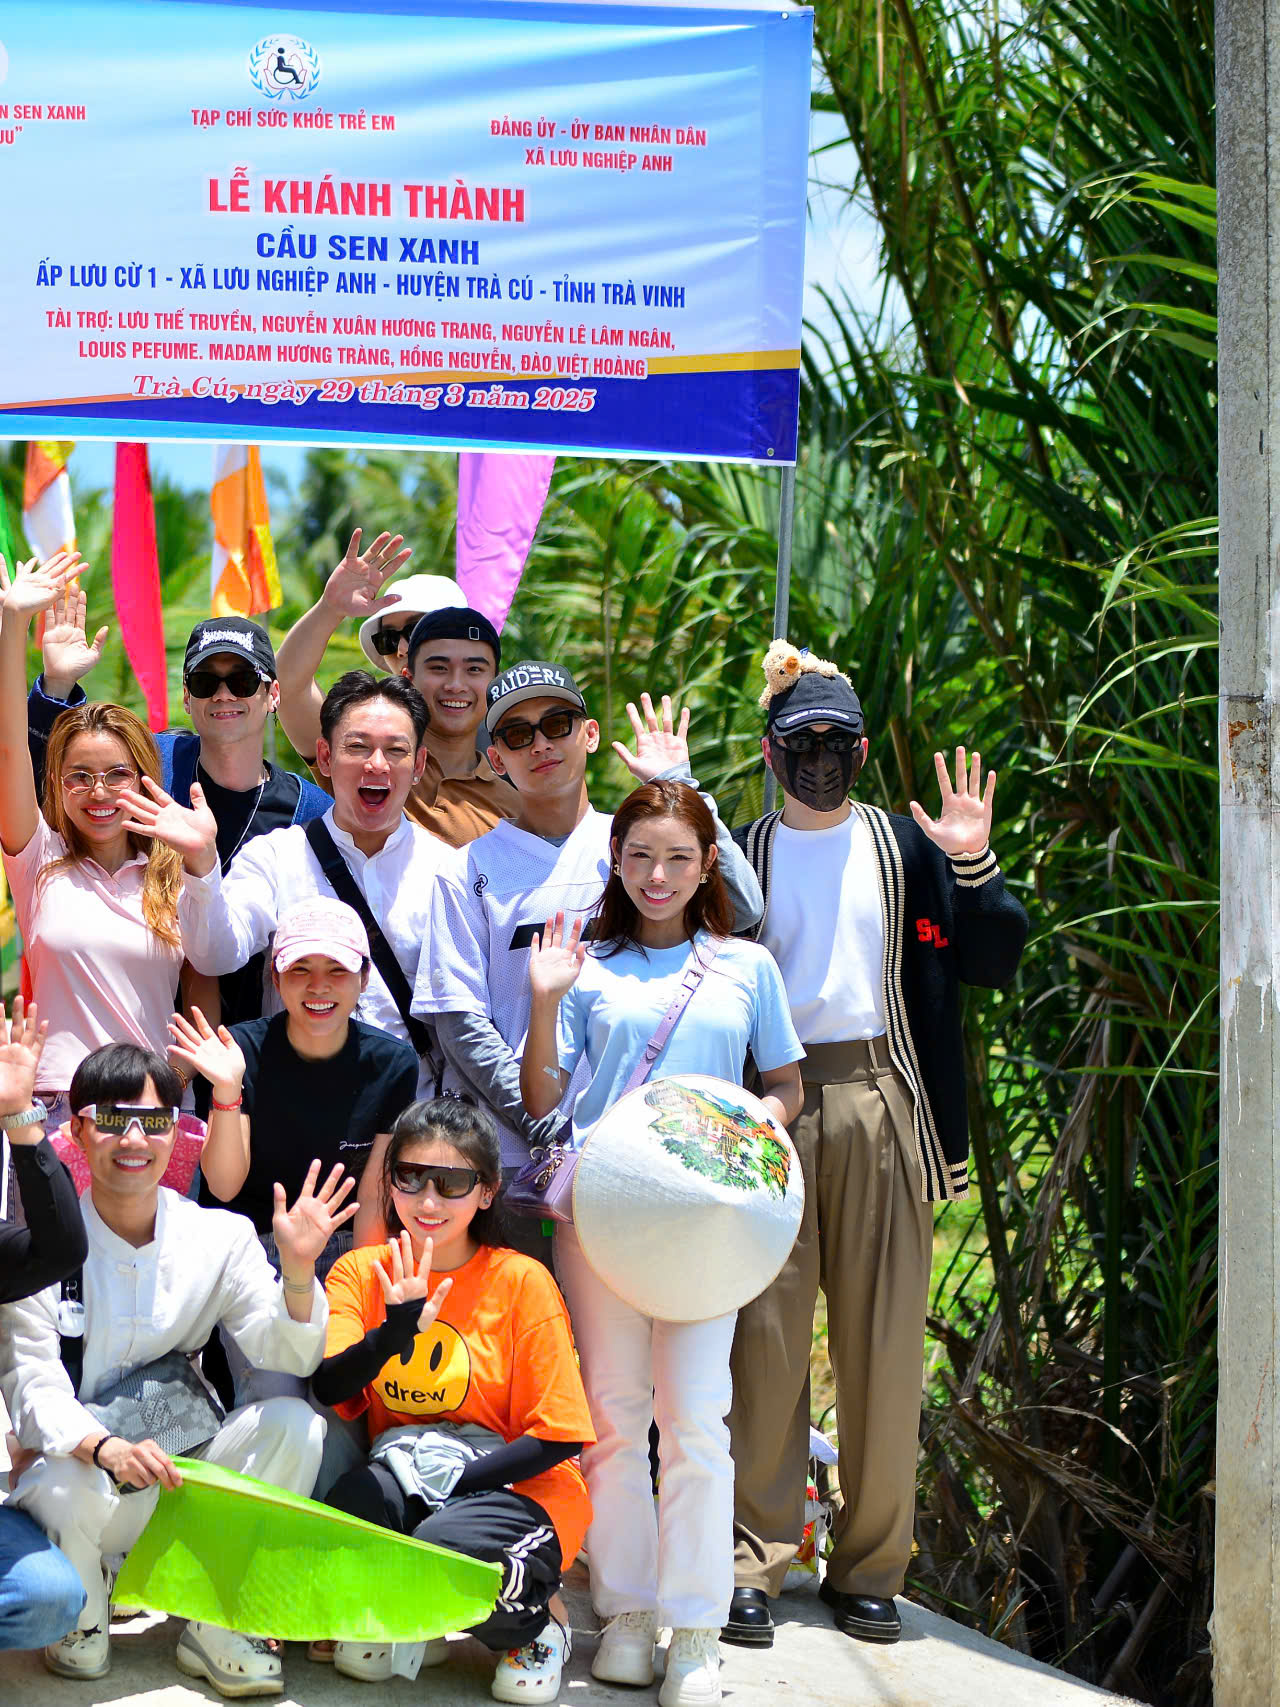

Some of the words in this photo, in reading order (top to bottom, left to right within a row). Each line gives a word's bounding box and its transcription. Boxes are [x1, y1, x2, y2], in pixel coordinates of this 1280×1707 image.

[13, 105, 42, 119] SEN
[47, 105, 86, 120] XANH
[192, 109, 220, 130] TẠP
[226, 108, 251, 127] CHÍ
[257, 108, 288, 128] SỨC
[293, 107, 333, 129] KHỎE
[338, 109, 366, 130] TRẺ
[372, 115, 395, 131] EM
[491, 115, 532, 137] ĐẢNG
[537, 117, 556, 138] ỦY
[571, 118, 589, 140] ỦY
[595, 124, 625, 141] BAN
[630, 124, 670, 144] NHÂN
[676, 127, 706, 146] DÂN
[526, 147, 544, 165] XÃ
[550, 149, 577, 167] LƯU
[583, 151, 637, 173] NGHIỆP
[642, 156, 672, 171] ANH
[209, 166, 250, 213] LỄ
[264, 174, 391, 216] KHÁNH
[404, 179, 524, 222] THÀNH
[256, 225, 317, 259] CẦU
[328, 234, 388, 262] SEN
[399, 238, 479, 265] XANH
[36, 257, 62, 286] ẤP
[70, 264, 107, 287] LƯU
[115, 261, 142, 287] CỪ
[148, 267, 156, 288] 1
[180, 264, 206, 289] XÃ
[214, 266, 249, 290] LƯU
[257, 266, 329, 297] NGHIỆP
[336, 271, 376, 294] ANH
[397, 271, 459, 302] HUYỆN
[467, 274, 501, 299] TRÀ
[508, 274, 533, 301] CÚ
[553, 273, 595, 304] TỈNH
[602, 279, 636, 306] TRÀ
[642, 285, 685, 308] VINH
[46, 307, 71, 328] TÀI
[77, 310, 113, 332] TRỢ:
[118, 310, 149, 329] LƯU
[155, 307, 184, 330] THẾ
[189, 309, 257, 334] TRUYỀN,
[262, 310, 327, 334] NGUYỄN
[333, 315, 376, 336] XUÂN
[382, 318, 436, 338] HƯƠNG
[441, 322, 497, 343] TRANG,
[502, 319, 564, 344] NGUYỄN
[570, 322, 586, 345] LÊ
[591, 325, 624, 346] LÂM
[629, 327, 676, 351] NGÂN,
[79, 341, 126, 358] LOUIS
[132, 342, 203, 360] PEFUME.
[210, 344, 271, 362] MADAM
[277, 344, 332, 364] HƯƠNG
[338, 345, 395, 368] TRÀNG,
[400, 344, 443, 369] HỒNG
[449, 347, 516, 373] NGUYỄN,
[521, 351, 552, 373] ĐÀO
[557, 355, 588, 380] VIỆT
[594, 355, 646, 377] HOÀNG
[133, 375, 181, 396] Trà
[191, 375, 237, 401] Cú,
[246, 380, 312, 403] ngày
[319, 381, 354, 401] 29
[360, 381, 442, 408] tháng
[446, 385, 462, 405] 3
[469, 386, 529, 407] năm
[534, 389, 595, 410] 2025
[916, 918, 949, 948] SL
[385, 1380, 446, 1403] drew
